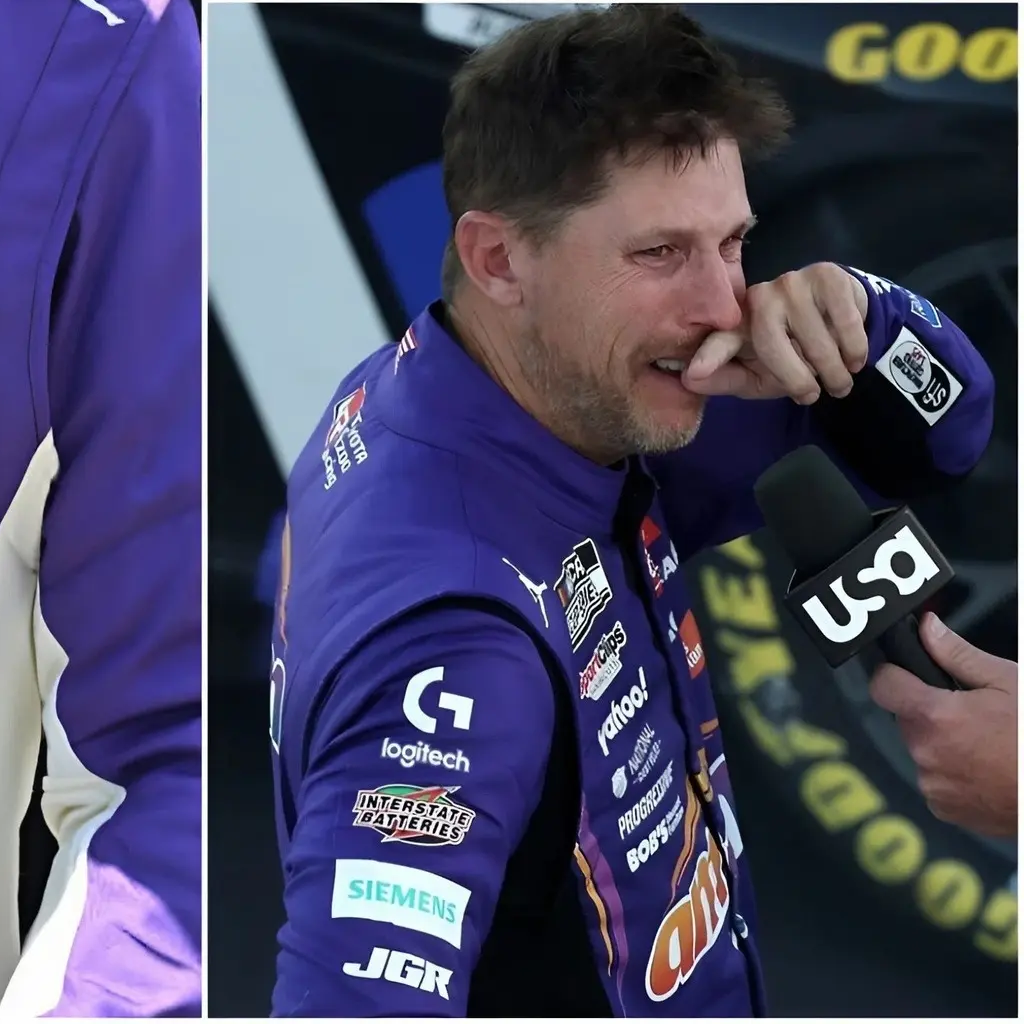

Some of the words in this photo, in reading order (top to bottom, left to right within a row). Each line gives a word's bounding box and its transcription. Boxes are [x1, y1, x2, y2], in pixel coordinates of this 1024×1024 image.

[598, 666, 649, 757] yahoo!
[380, 737, 471, 774] logitech
[359, 794, 471, 826] INTERSTATE
[360, 812, 462, 840] BATTERIES
[626, 818, 669, 873] BOB'S
[347, 879, 456, 923] SIEMENS
[342, 946, 454, 1001] JGR
